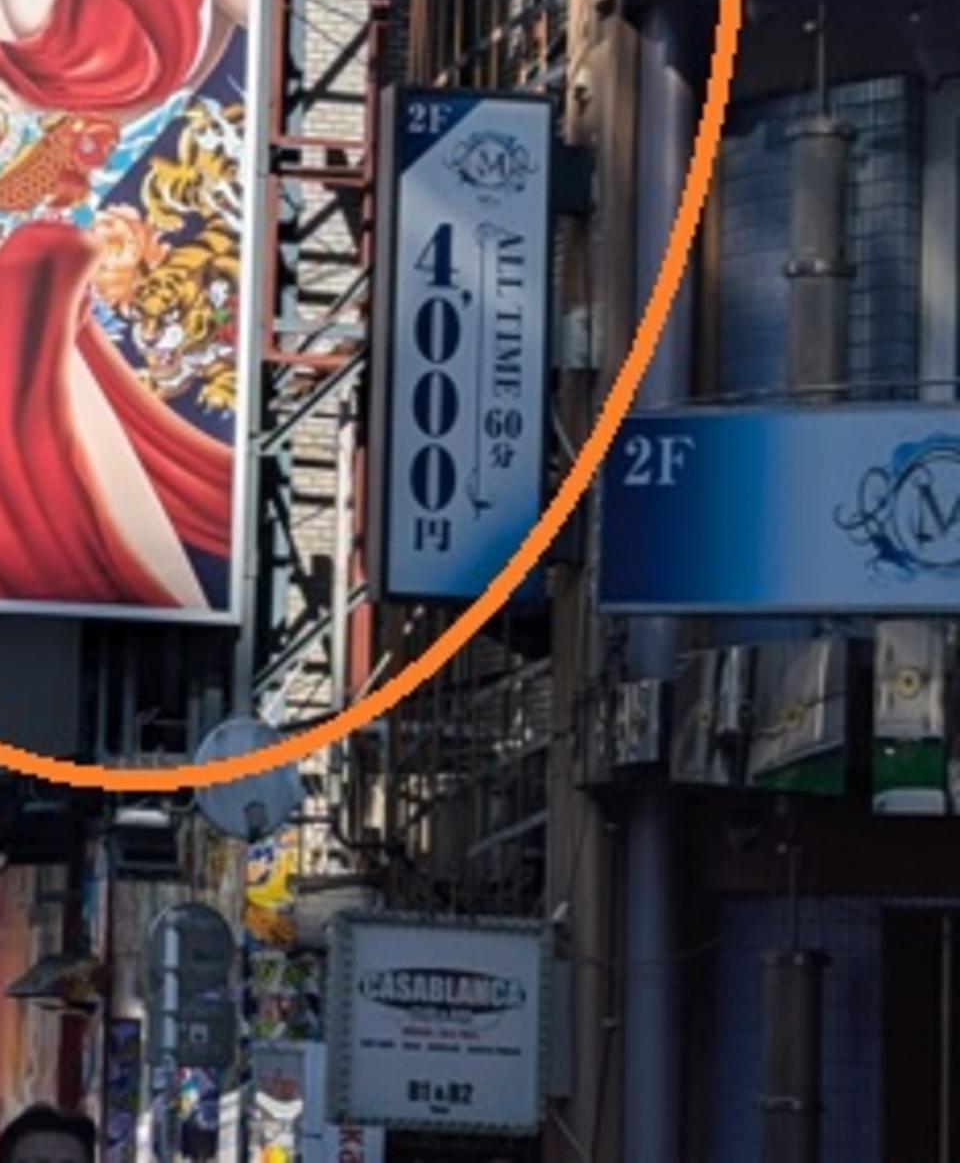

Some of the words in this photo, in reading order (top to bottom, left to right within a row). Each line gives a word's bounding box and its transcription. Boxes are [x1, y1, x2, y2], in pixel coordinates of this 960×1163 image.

[407, 103, 454, 134] 2F
[496, 234, 525, 297] ALL
[493, 303, 523, 399] TIME
[622, 434, 695, 487] 2F
[361, 971, 526, 1011] CASABLANCA
